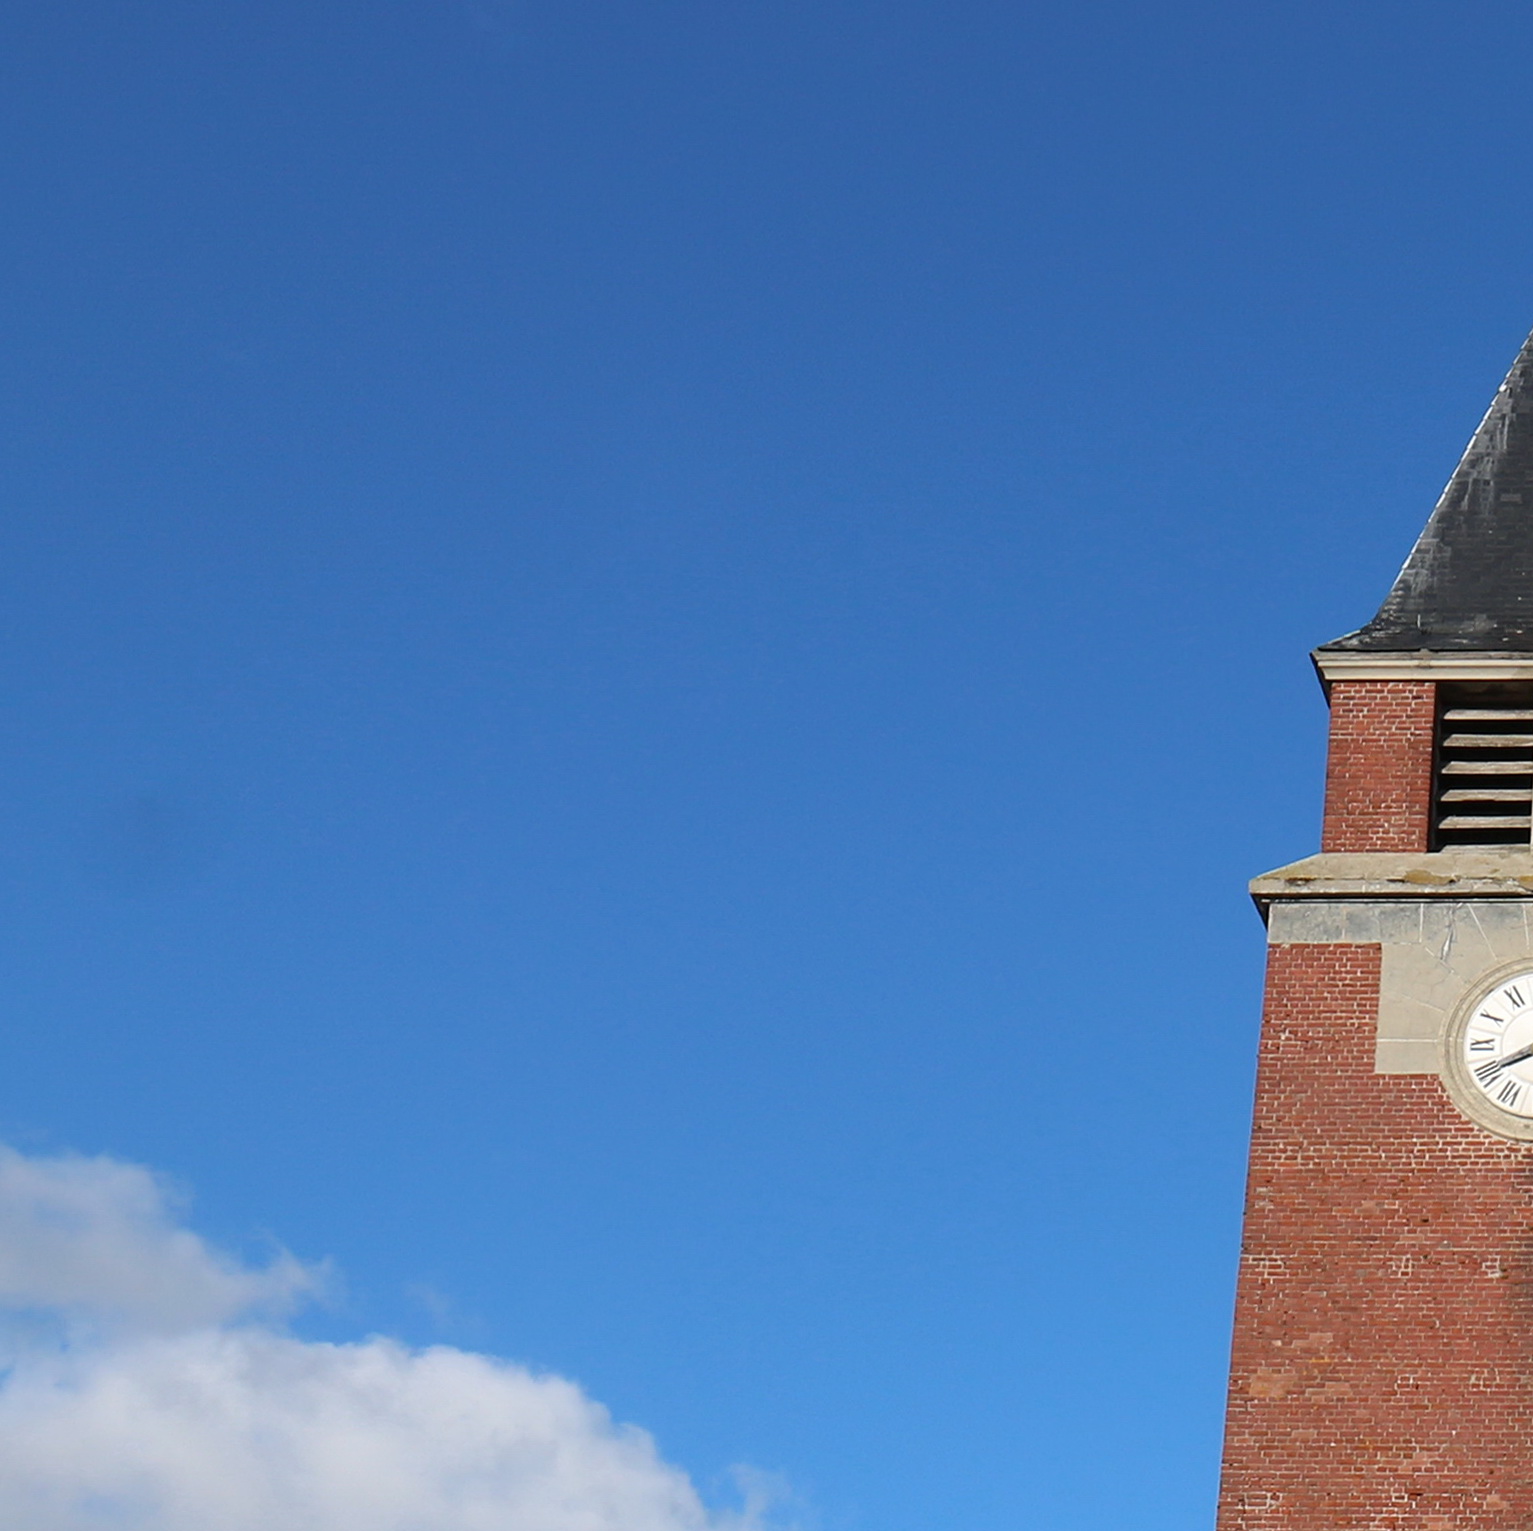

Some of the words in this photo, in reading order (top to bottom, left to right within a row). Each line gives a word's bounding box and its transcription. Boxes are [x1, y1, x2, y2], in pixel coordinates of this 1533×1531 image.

[1503, 985, 1525, 1010] XI
[1480, 1008, 1504, 1028] X
[1469, 1038, 1495, 1051] IX
[1496, 1080, 1521, 1107] VII
